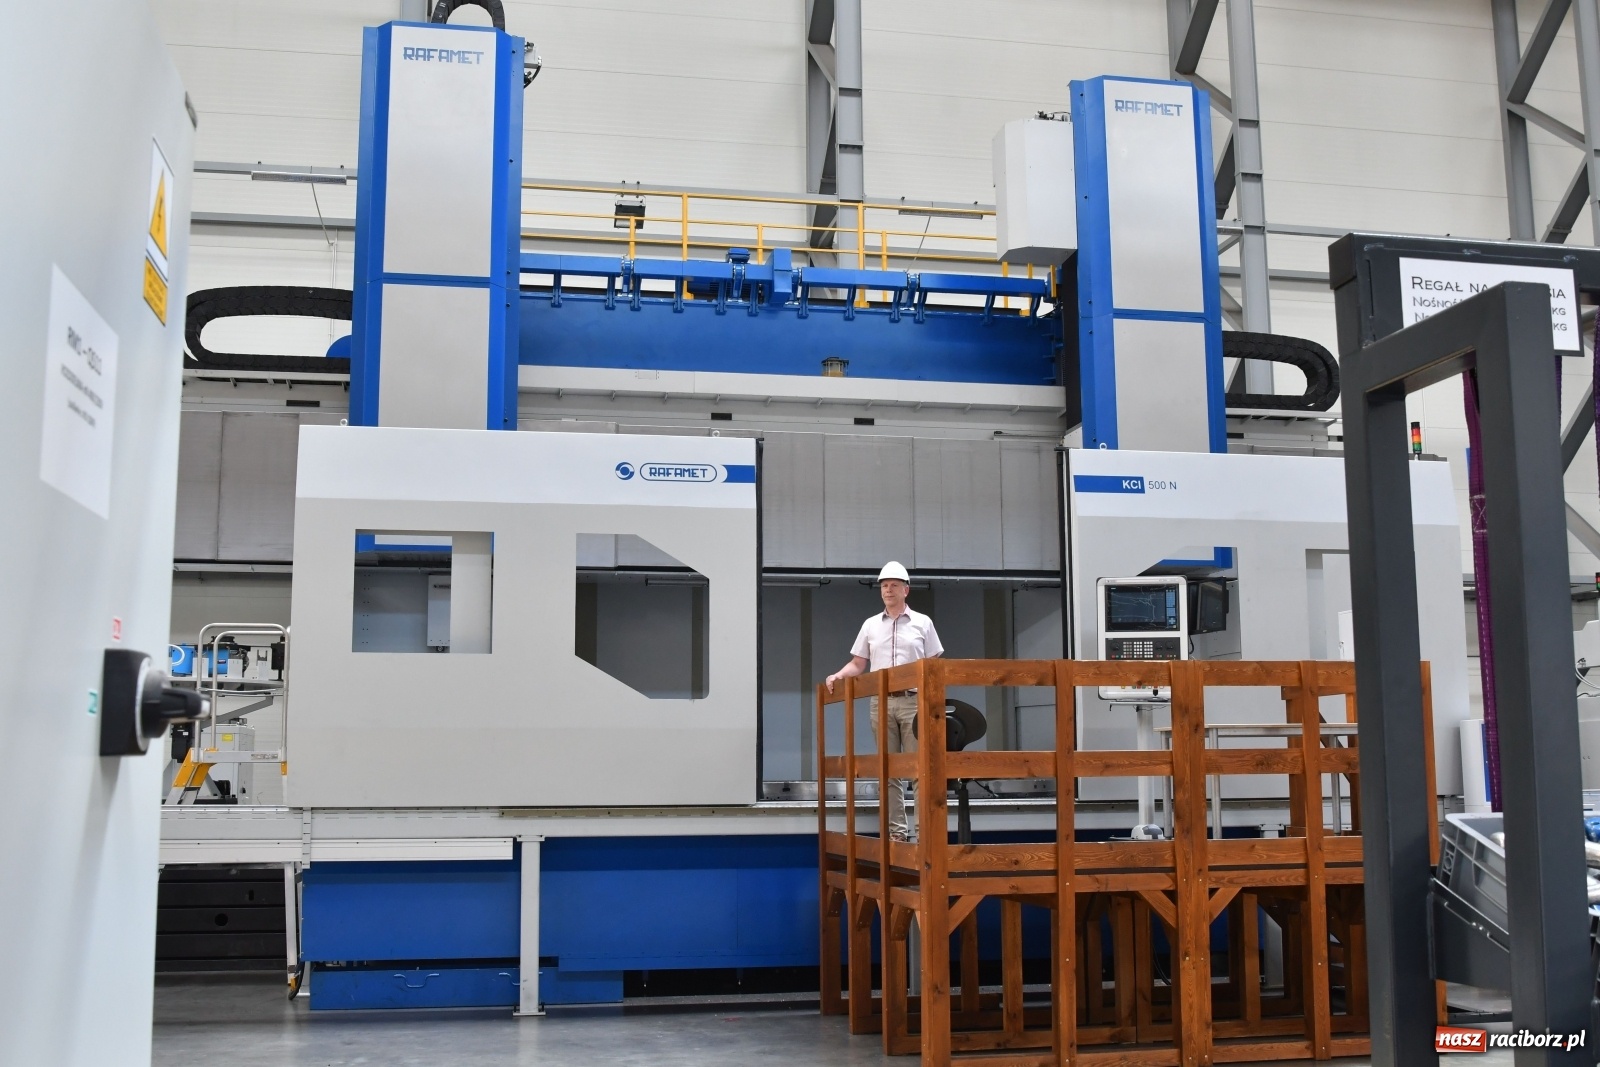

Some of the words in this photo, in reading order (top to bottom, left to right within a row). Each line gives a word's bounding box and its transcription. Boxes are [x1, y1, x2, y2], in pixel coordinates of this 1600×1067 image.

[403, 46, 484, 65] RAFAMET
[1114, 99, 1183, 116] RAFAMET
[648, 467, 708, 478] RAFAMET
[1122, 479, 1142, 490] KCI
[1148, 480, 1167, 490] 500
[1169, 481, 1177, 490] N
